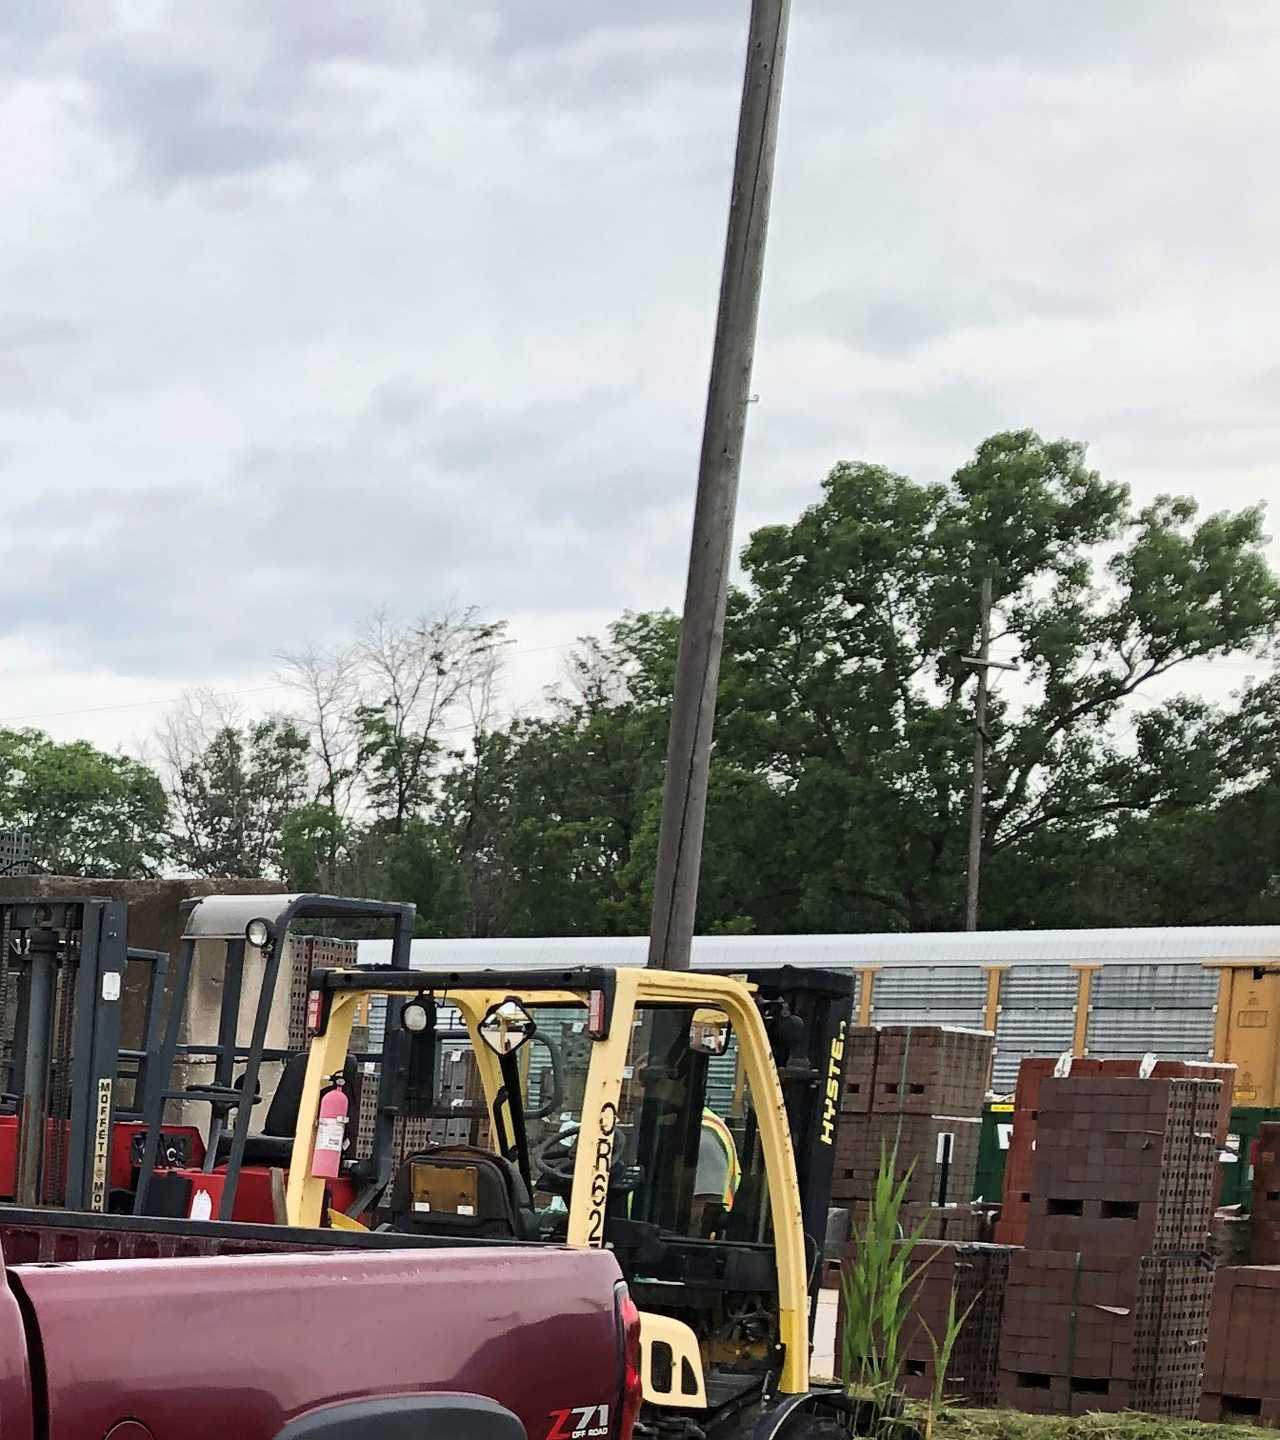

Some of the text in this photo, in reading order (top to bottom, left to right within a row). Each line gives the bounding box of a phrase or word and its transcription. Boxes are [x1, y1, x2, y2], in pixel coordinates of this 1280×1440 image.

[96, 1082, 110, 1163] MOFFETT
[588, 1102, 616, 1248] OR62
[571, 1427, 609, 1439] OFF ROAD
